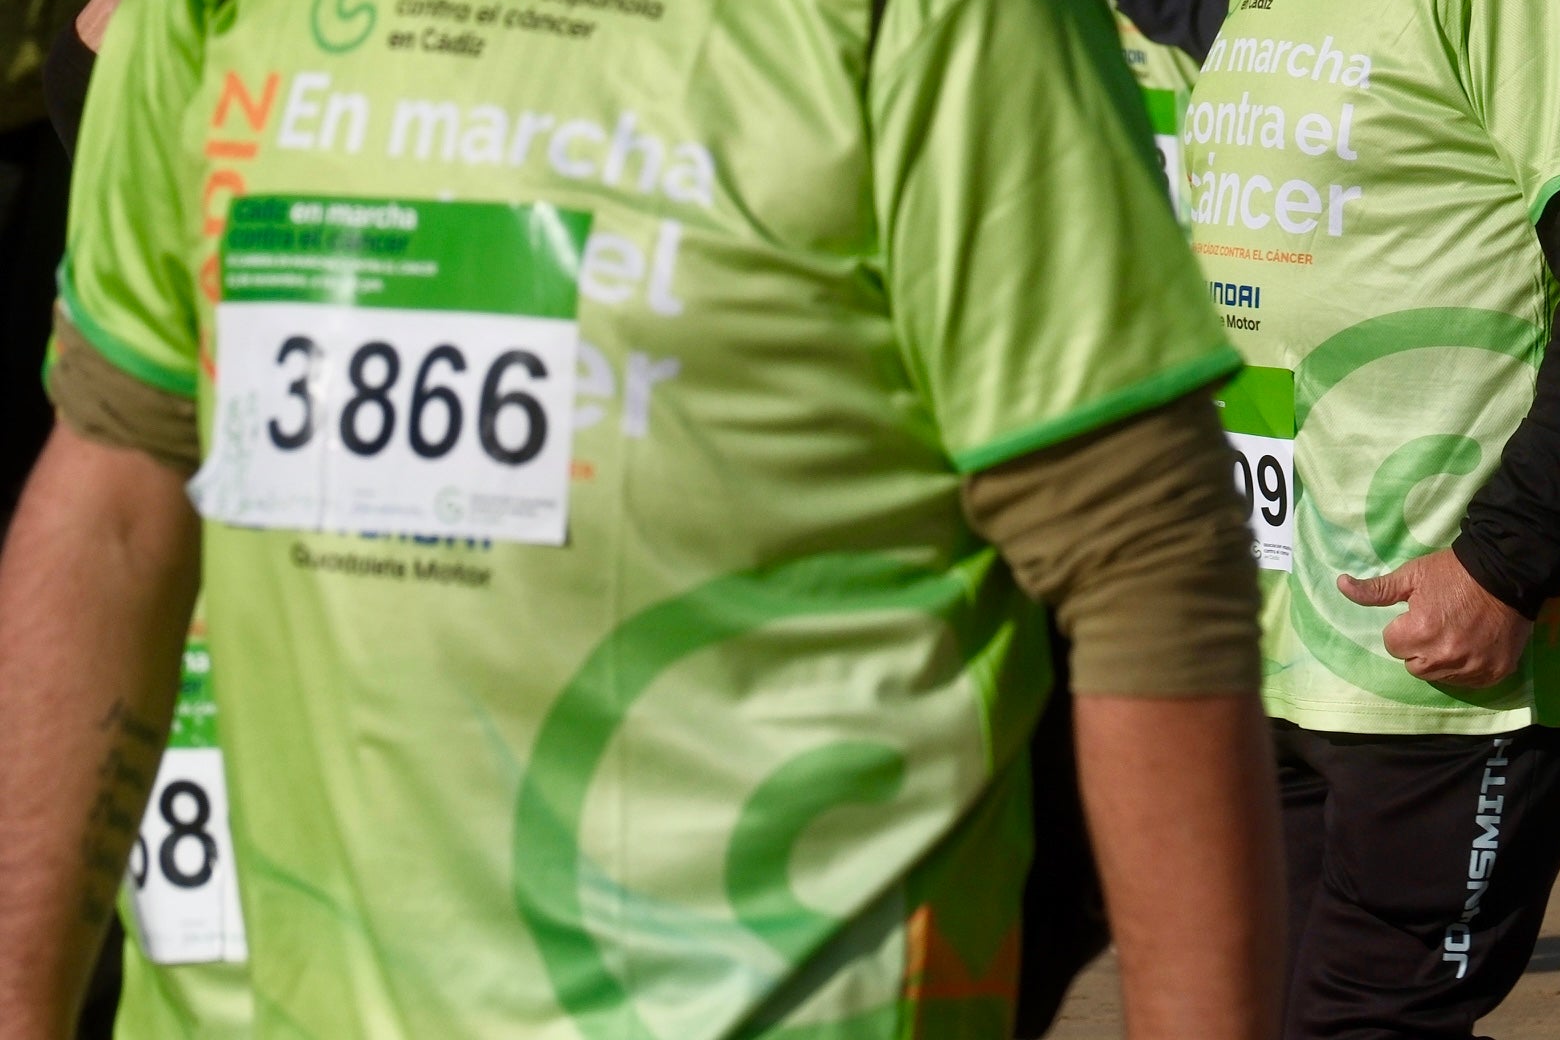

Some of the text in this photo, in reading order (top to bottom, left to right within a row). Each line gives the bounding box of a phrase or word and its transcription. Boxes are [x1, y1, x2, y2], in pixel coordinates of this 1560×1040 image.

[1227, 33, 1373, 90] marcha
[277, 71, 719, 208] En marcha
[1184, 90, 1359, 161] contra el
[1252, 248, 1264, 262] EL
[1265, 248, 1314, 265] CÁNCER
[1209, 280, 1261, 309] NDAI
[1226, 313, 1261, 331] Motor
[267, 334, 550, 468] 3866
